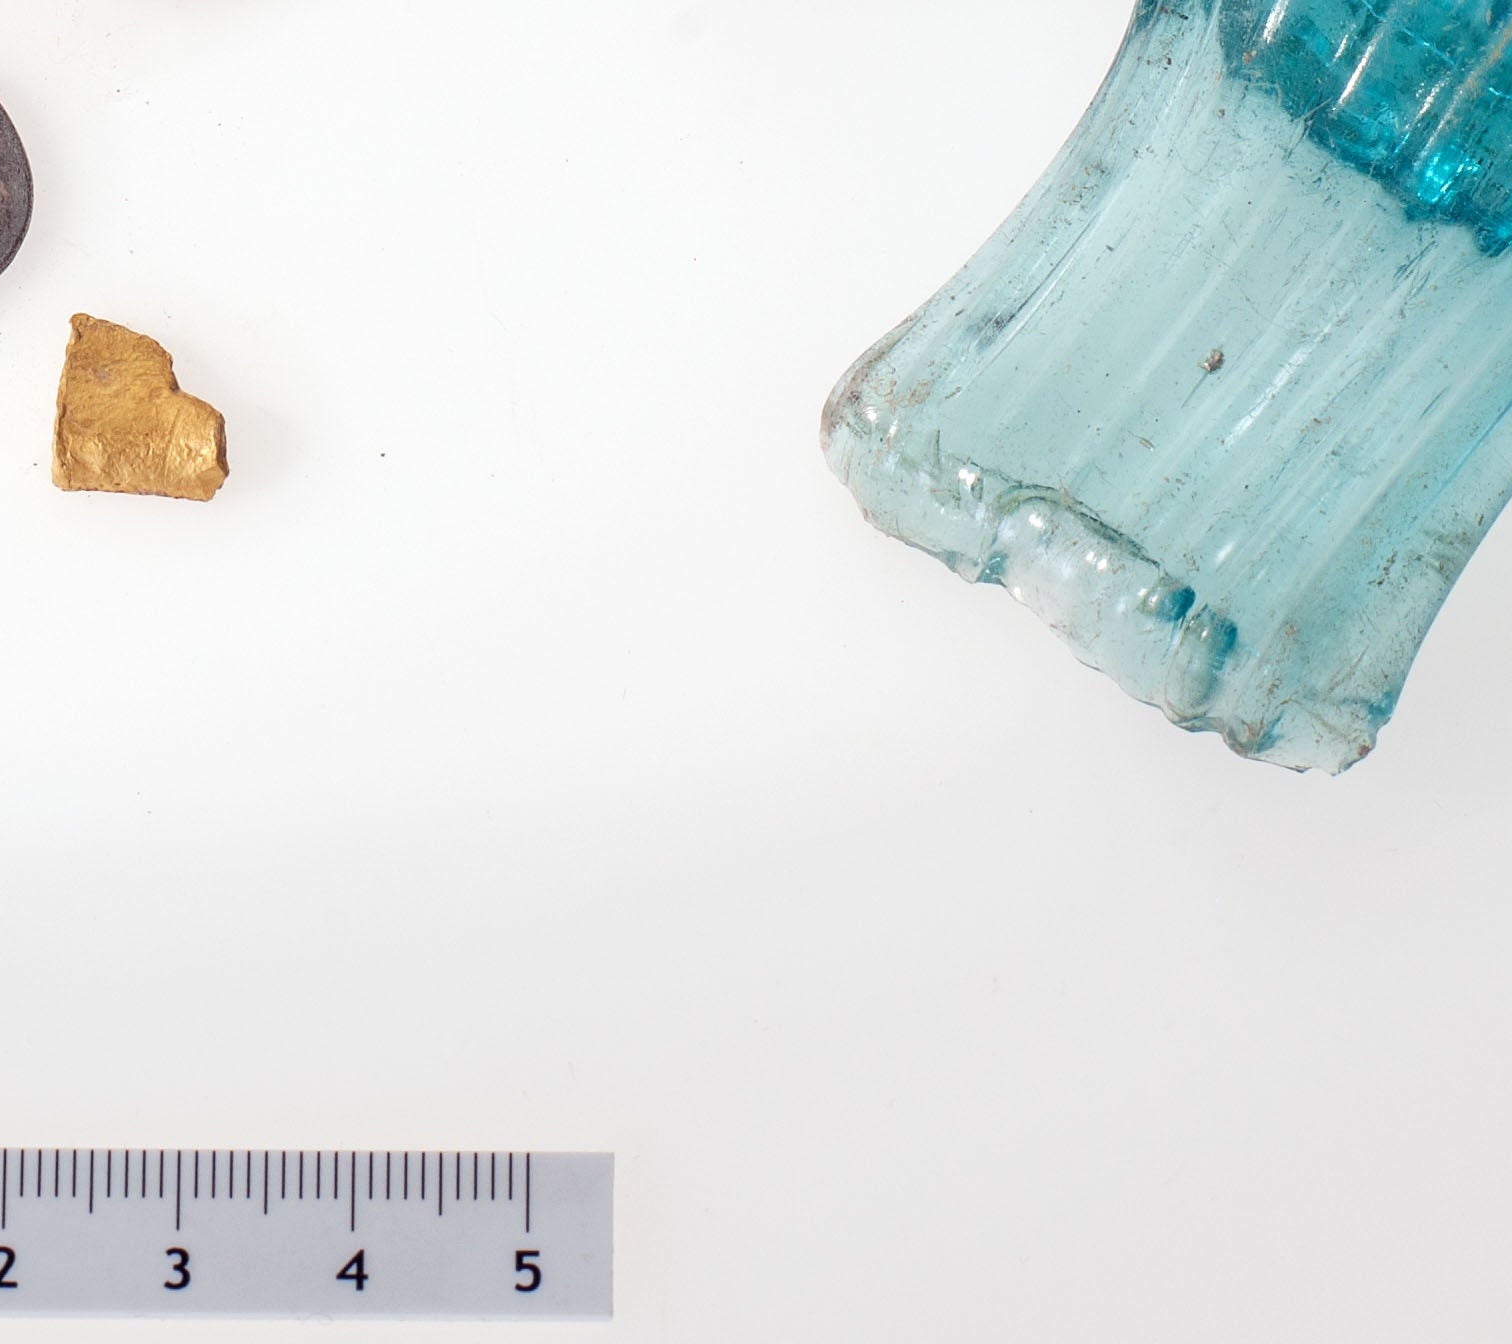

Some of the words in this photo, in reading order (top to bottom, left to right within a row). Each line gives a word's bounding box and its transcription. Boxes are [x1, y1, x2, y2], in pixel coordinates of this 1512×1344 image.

[163, 1247, 191, 1291] 3
[335, 1248, 369, 1292] 4
[514, 1249, 542, 1293] 5
